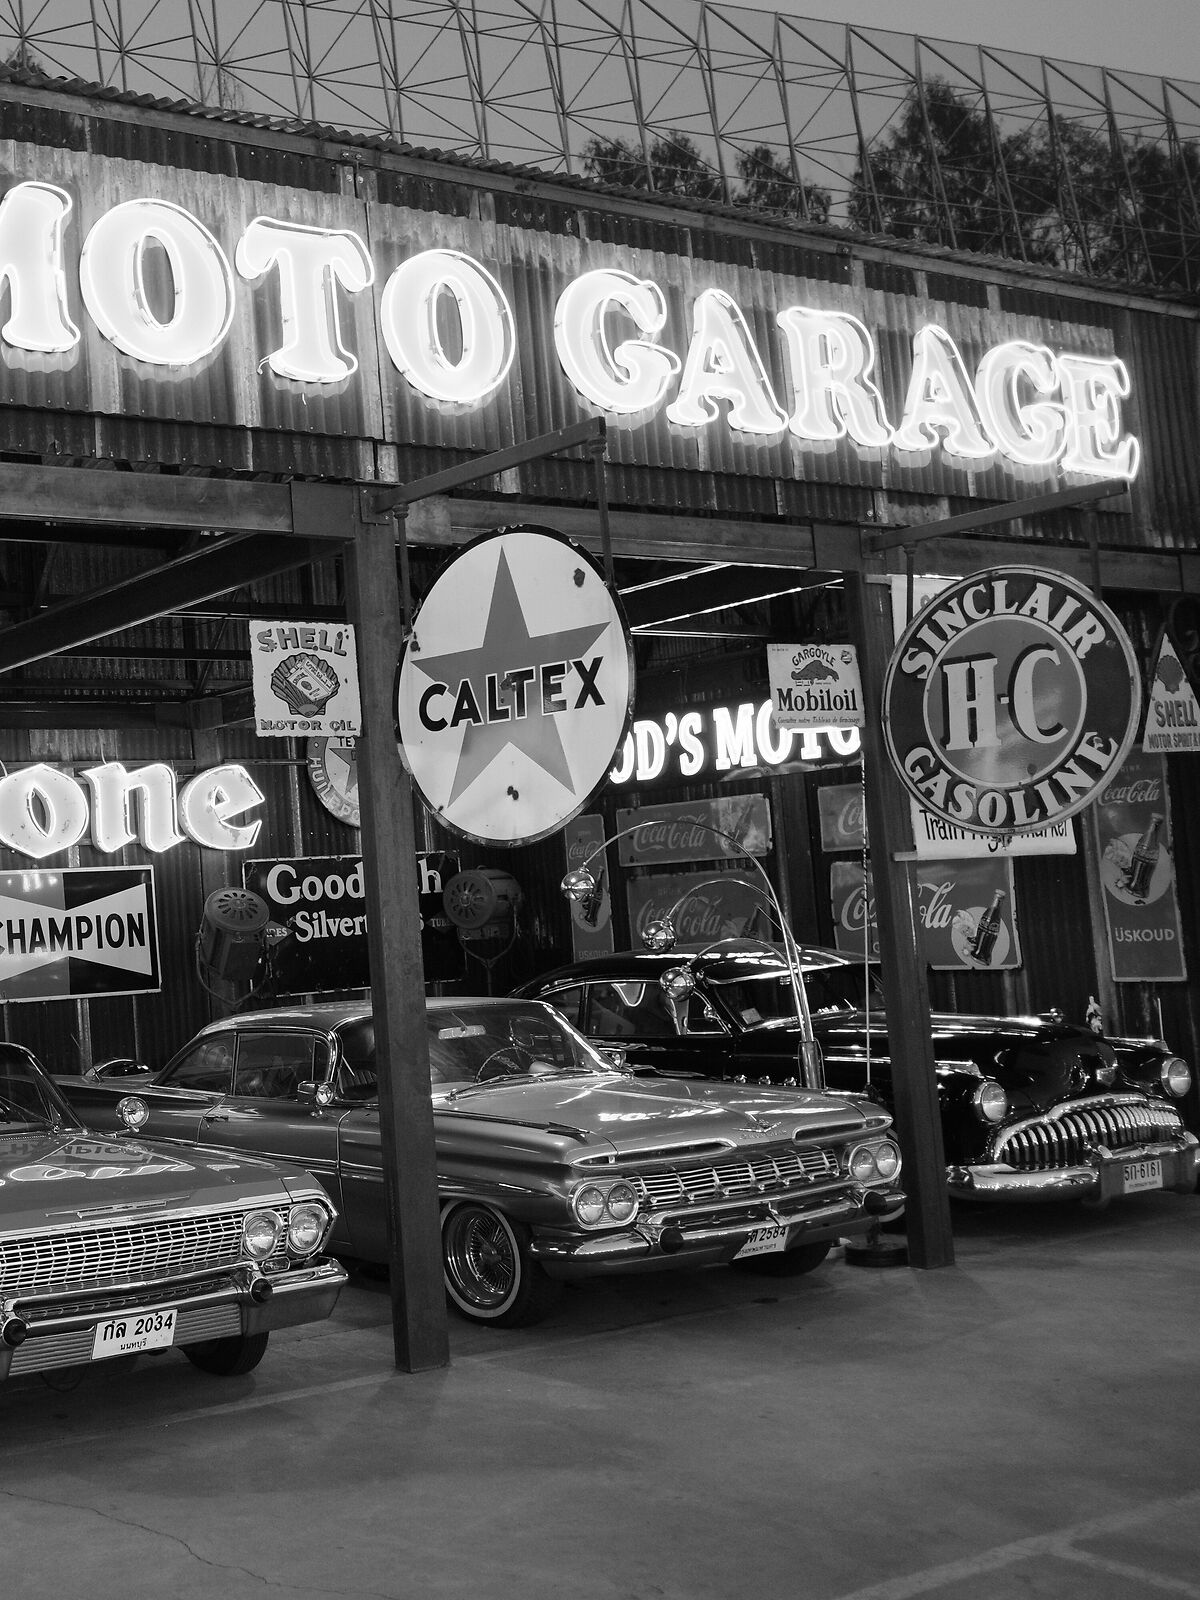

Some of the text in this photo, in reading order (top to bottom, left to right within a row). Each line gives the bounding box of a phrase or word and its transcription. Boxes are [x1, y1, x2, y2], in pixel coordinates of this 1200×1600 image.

[554, 269, 1140, 480] GARAGE
[256, 627, 348, 657] SHELL
[901, 579, 1106, 680] SINCLAIR
[791, 647, 836, 667] GARGOYLE
[418, 655, 606, 732] CALTEX
[776, 688, 858, 711] Mobiloil
[260, 719, 357, 732] MOTOR OIL
[1154, 700, 1198, 728] SHELL
[904, 731, 1119, 827] GASOLINE
[134, 1312, 173, 1335] 2034
